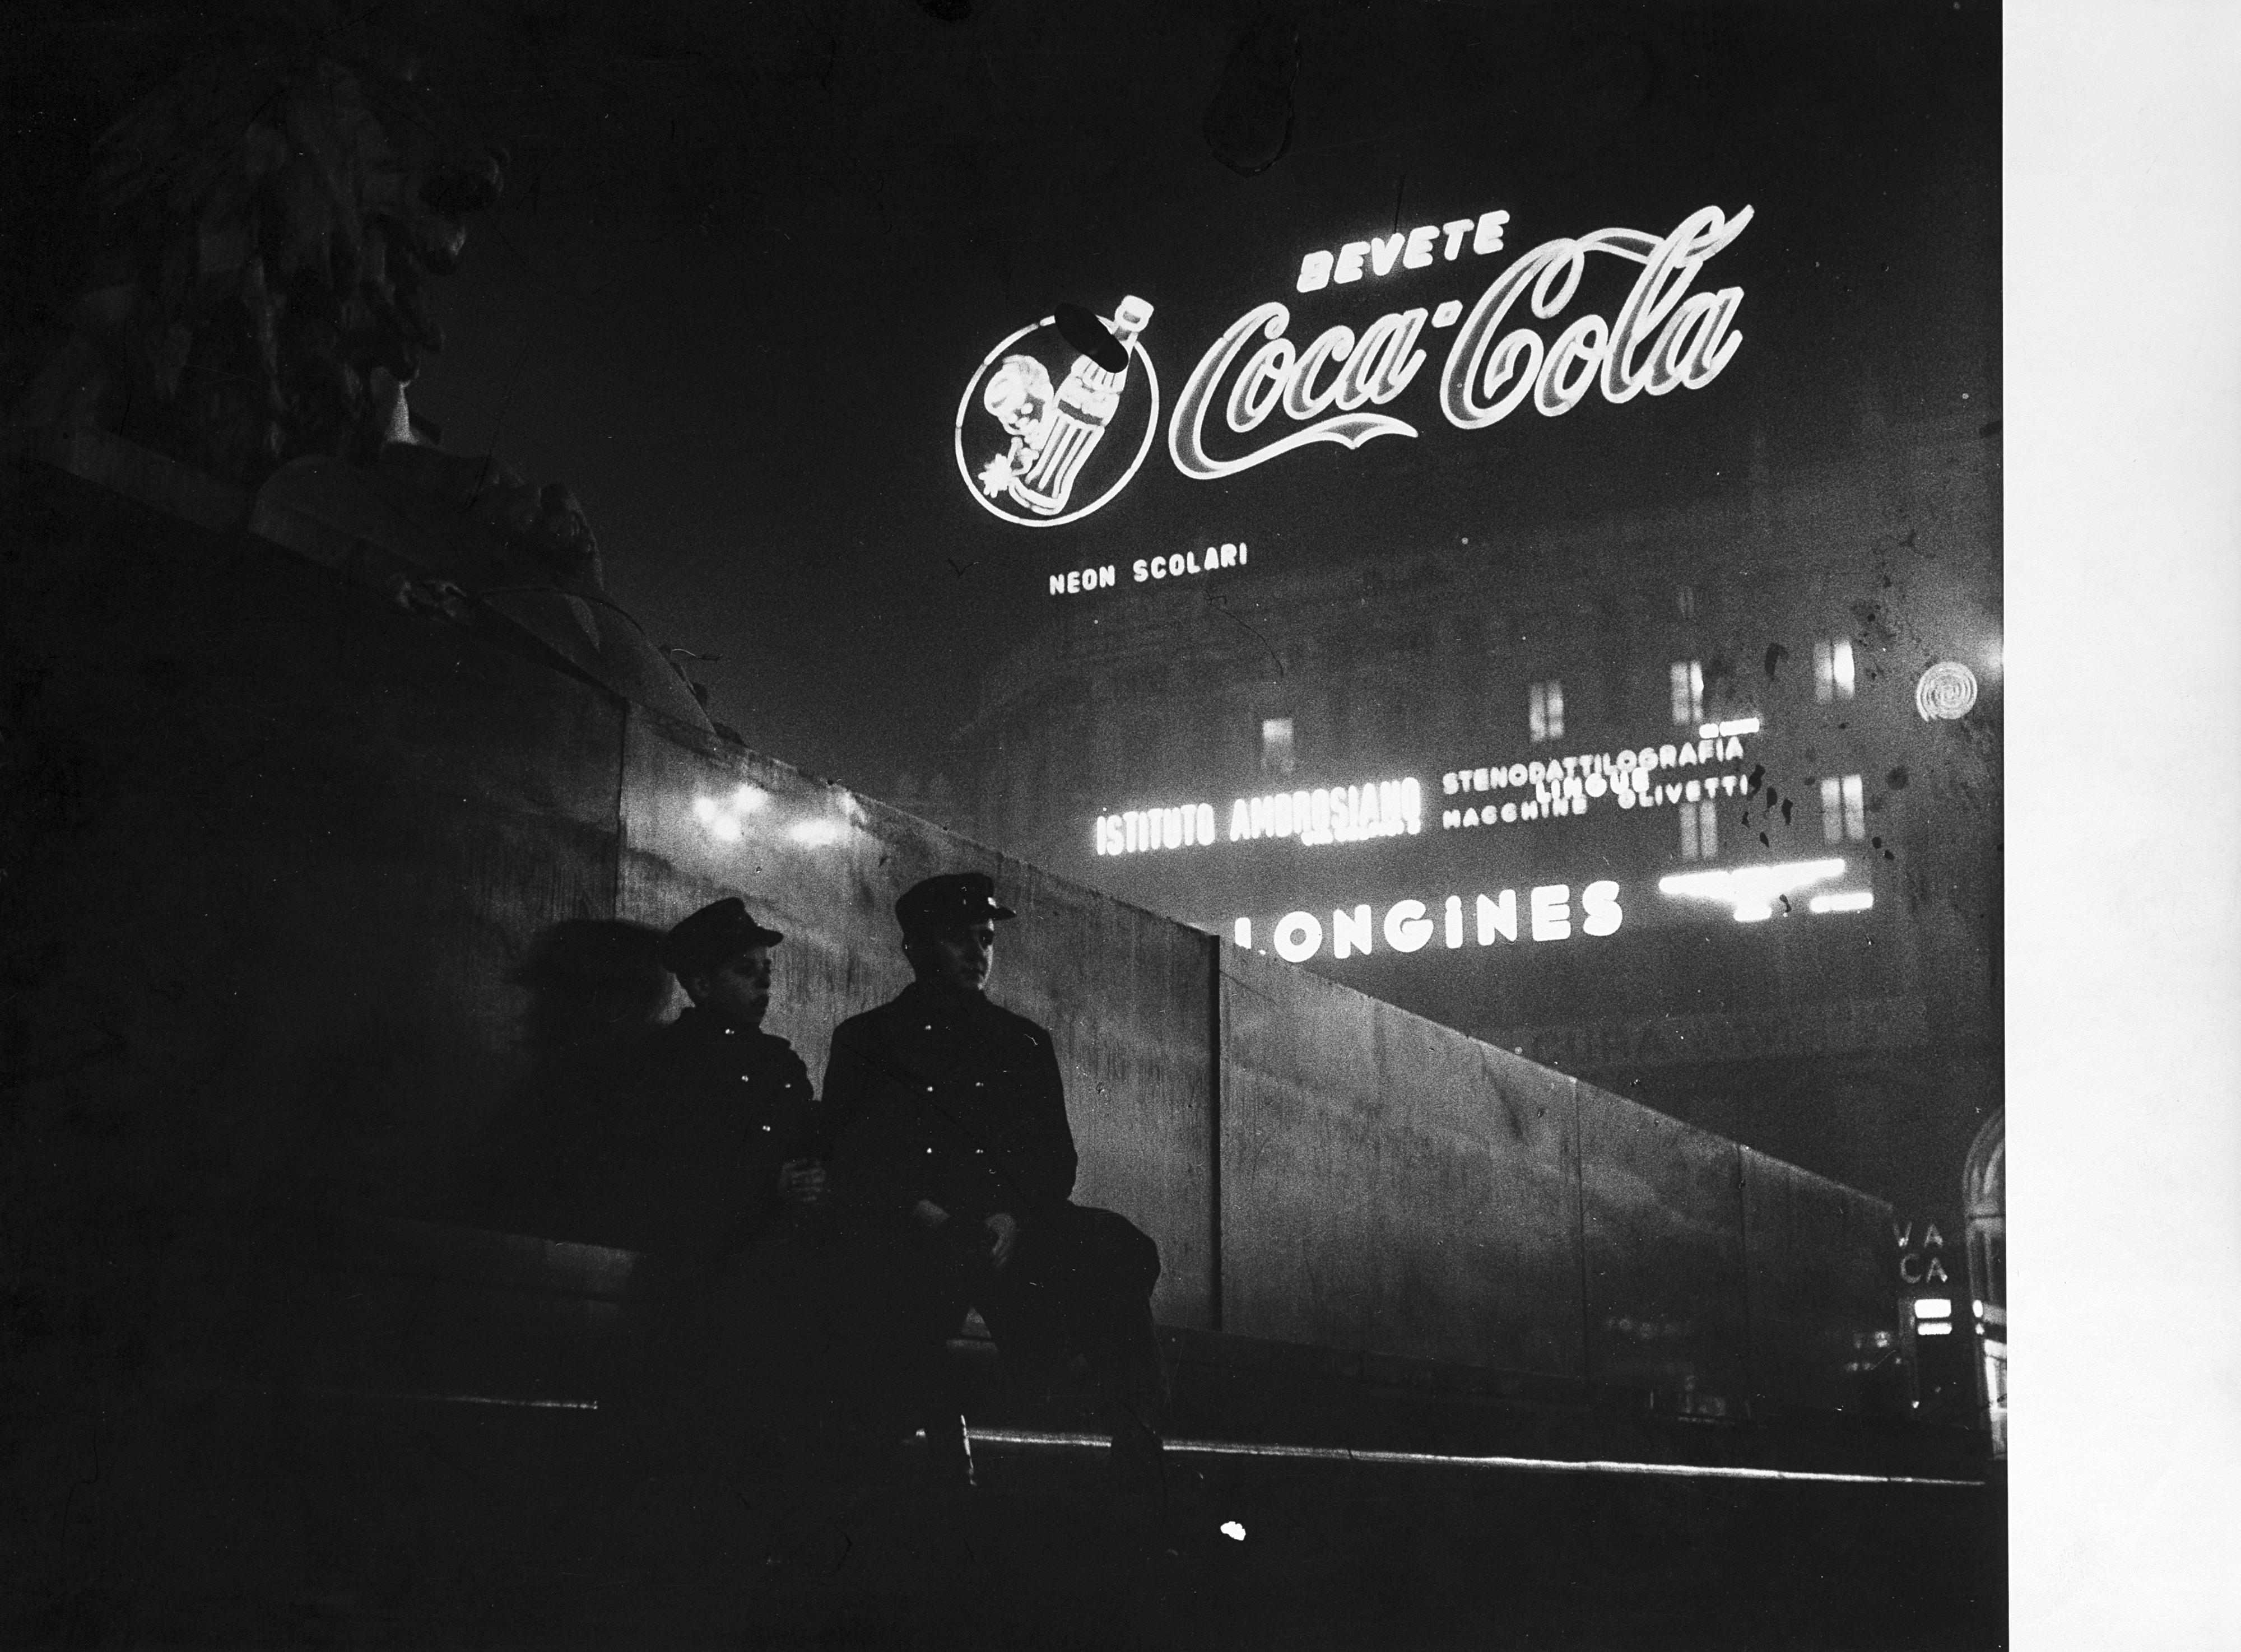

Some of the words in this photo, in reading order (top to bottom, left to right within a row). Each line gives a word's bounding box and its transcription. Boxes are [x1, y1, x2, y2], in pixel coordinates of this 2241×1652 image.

[1296, 209, 1511, 294] BEVETE
[1049, 565, 1115, 595] NEON
[1133, 542, 1247, 582] SCOLARI
[1442, 736, 1744, 795] STENODATTILOGRAFIA
[1617, 774, 1749, 809] OLIVETTI
[1096, 802, 1215, 855] ISTITUTO
